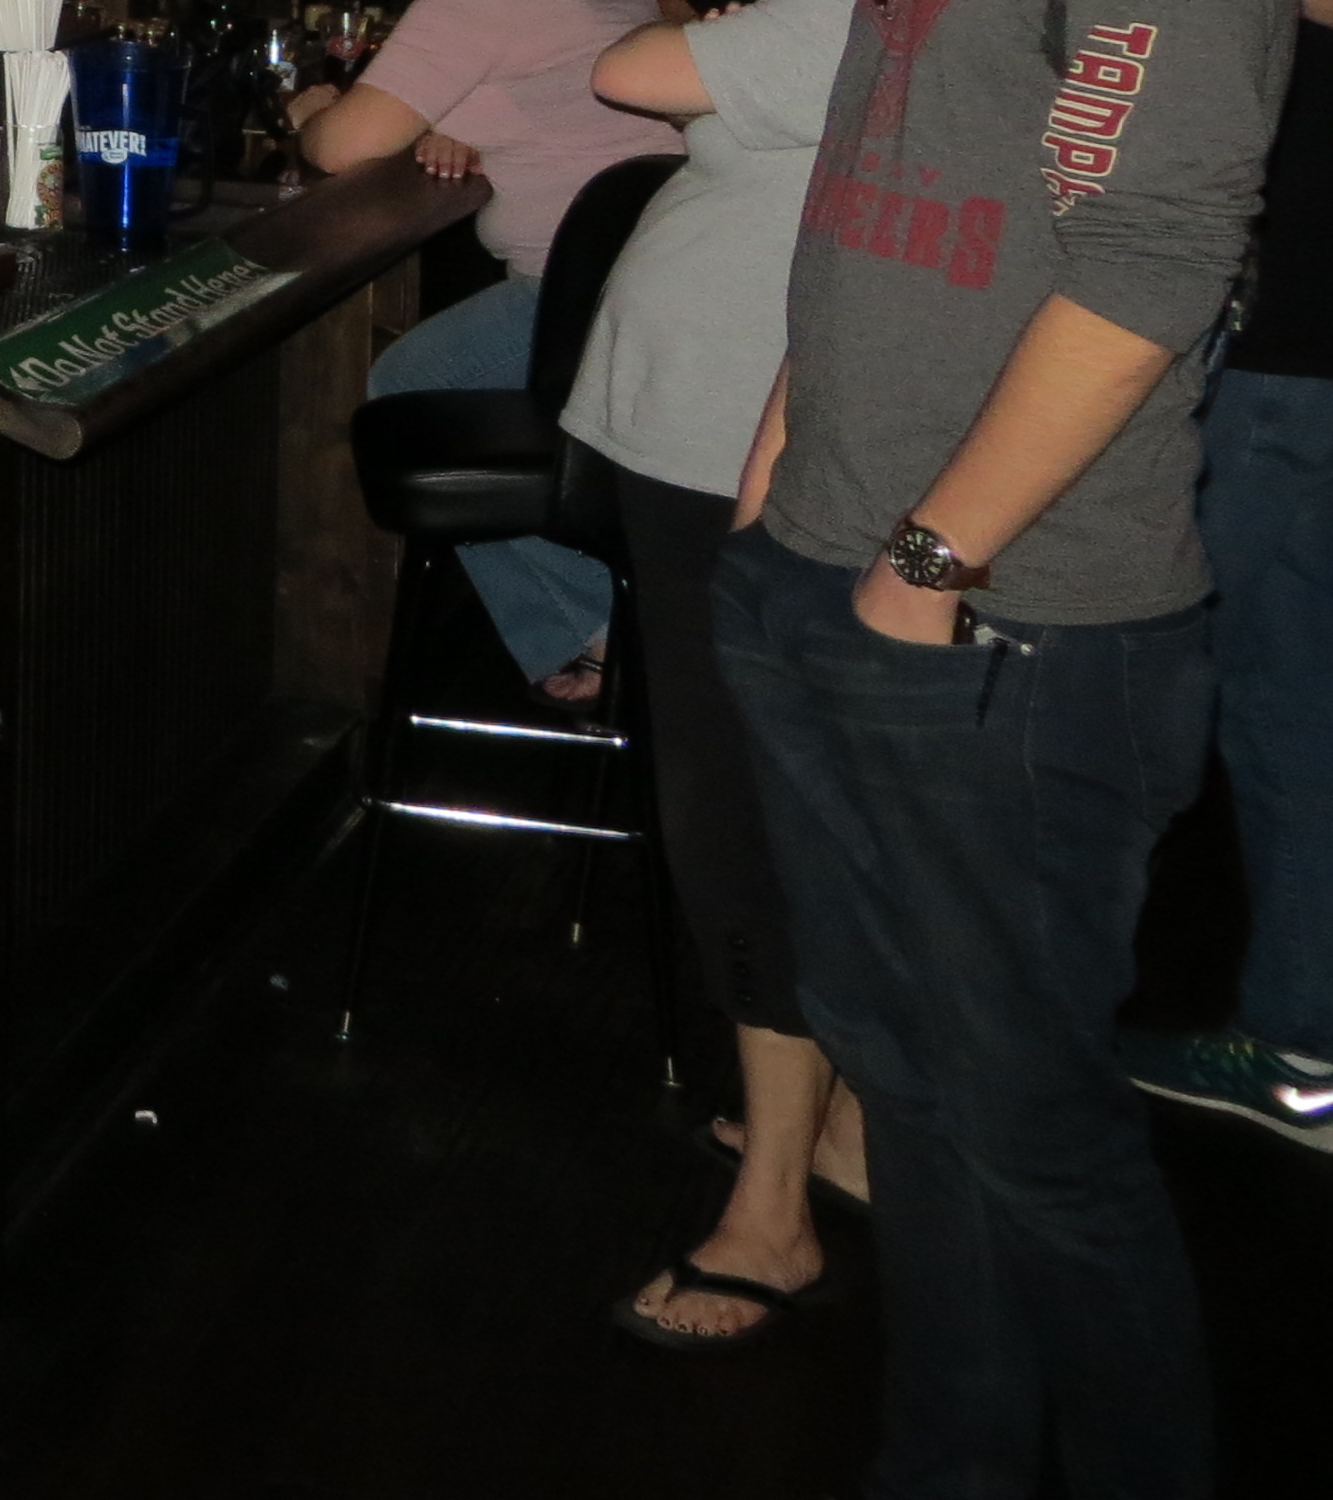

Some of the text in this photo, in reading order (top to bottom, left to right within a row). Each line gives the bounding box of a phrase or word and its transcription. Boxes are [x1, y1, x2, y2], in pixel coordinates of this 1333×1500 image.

[23, 352, 86, 389] Do
[59, 324, 125, 369] Not
[112, 287, 199, 346] Stand
